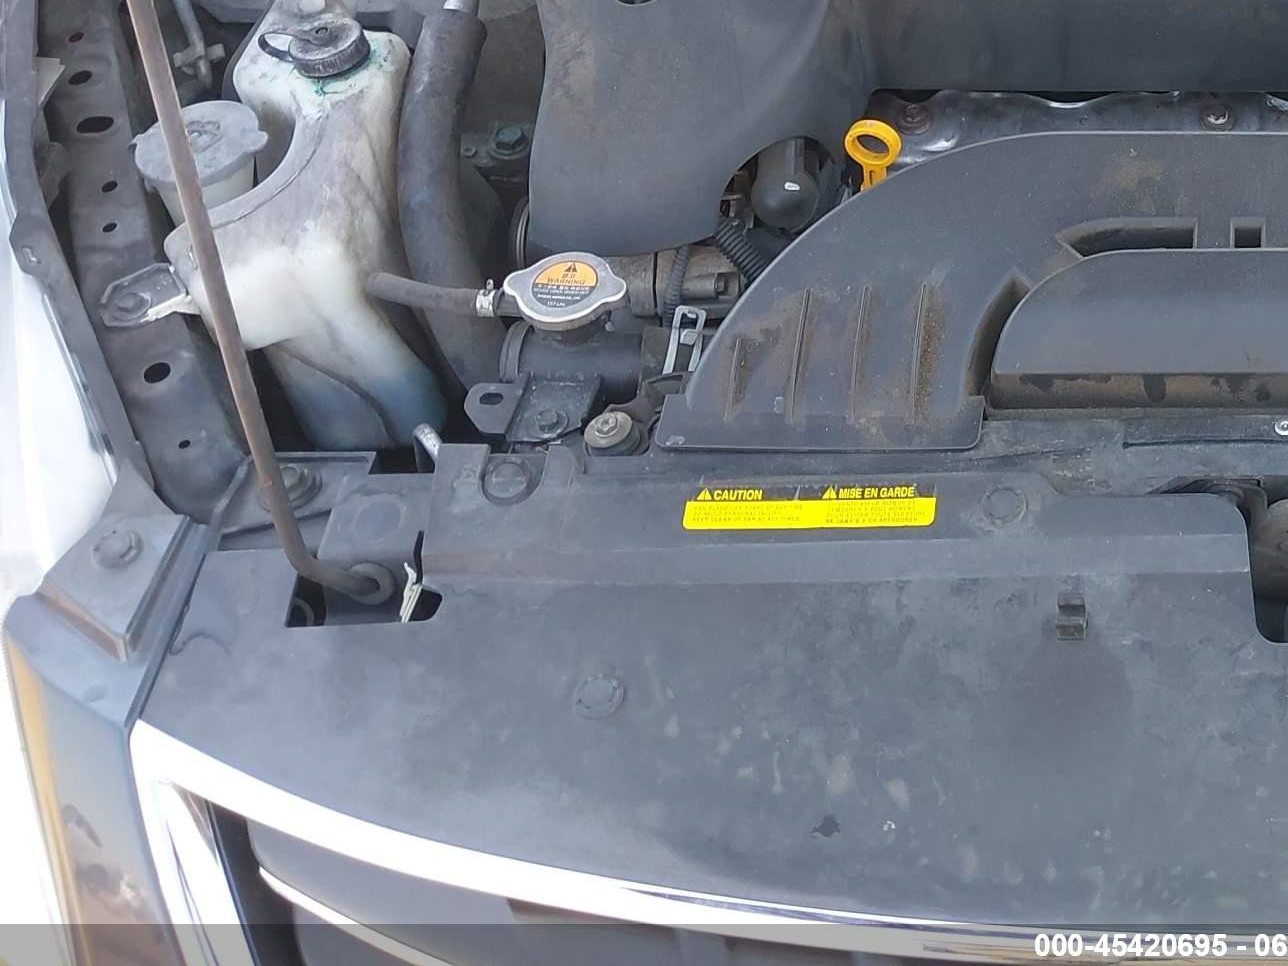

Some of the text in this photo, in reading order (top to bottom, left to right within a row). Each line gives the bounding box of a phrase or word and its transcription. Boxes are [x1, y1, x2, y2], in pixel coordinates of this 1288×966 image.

[547, 277, 586, 285] WARNING
[713, 489, 762, 500] CAUTION
[838, 486, 915, 498] MISE EN GARDE
